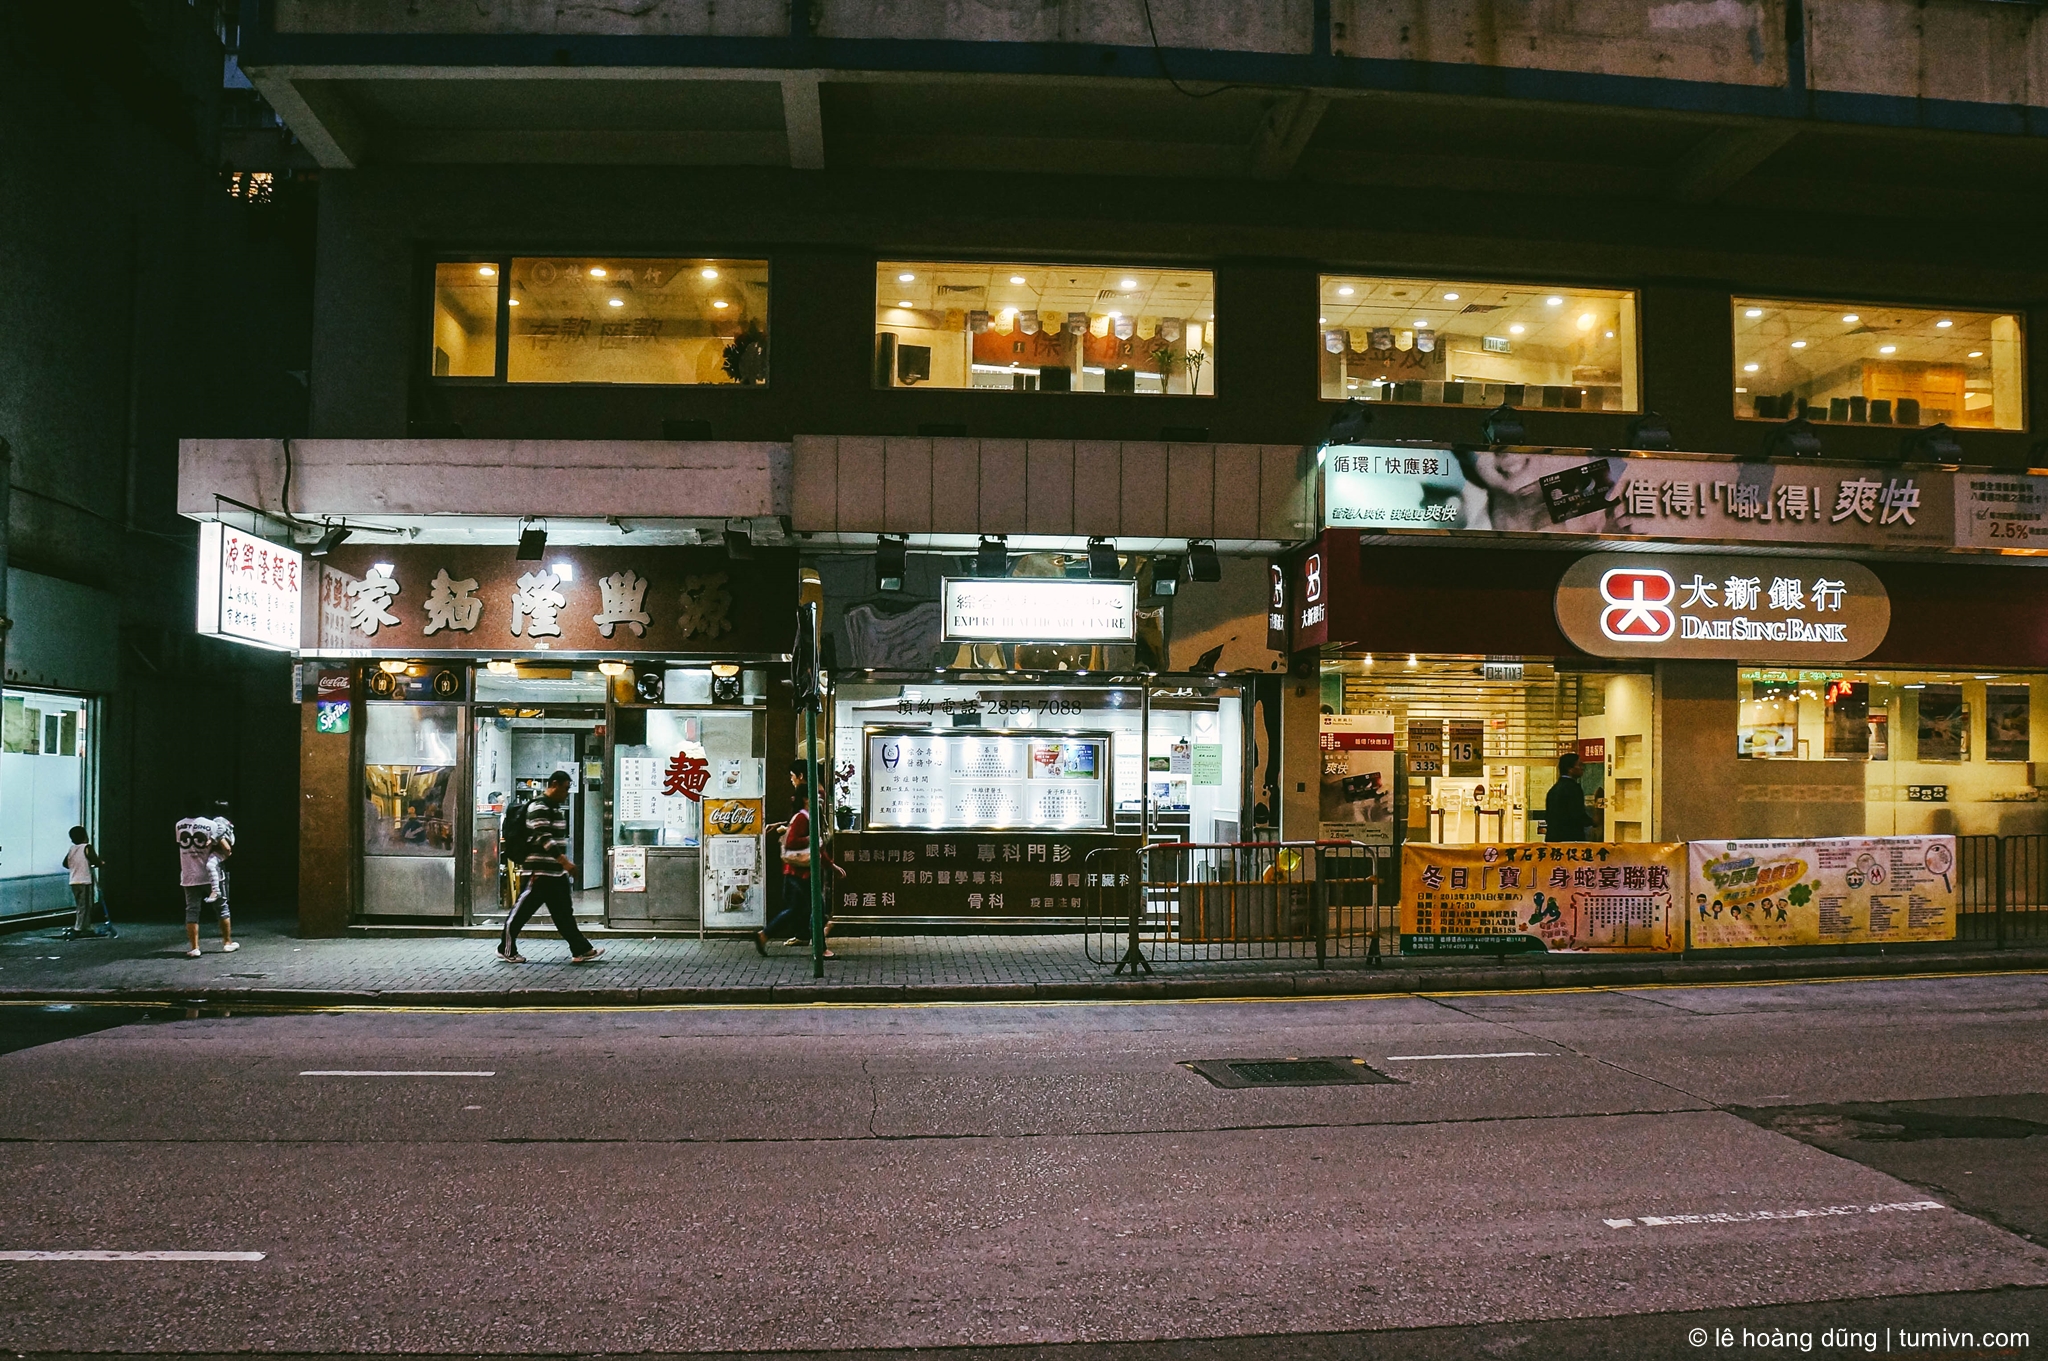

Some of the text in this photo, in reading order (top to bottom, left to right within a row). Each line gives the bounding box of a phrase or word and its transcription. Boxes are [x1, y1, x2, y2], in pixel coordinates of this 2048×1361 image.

[1334, 456, 1449, 476] 循環「快應錢」
[1831, 477, 1922, 525] 爽快
[1990, 522, 2029, 539] 2.5%
[1680, 574, 1848, 612] 大新銀行
[953, 615, 996, 627] EXPERT
[1082, 617, 1126, 629] CENTRE
[897, 699, 1082, 716] 預約電話 2855 7088
[320, 703, 349, 730] Sprite
[661, 751, 711, 802] 麵
[1325, 762, 1348, 774] 爽快
[926, 844, 956, 857] 眼科
[977, 844, 1071, 863] 專科門診
[1504, 847, 1610, 862] 寶石事務促進會
[903, 871, 1003, 885] 預防醫學專科
[1421, 865, 1670, 890] 冬日「寶」身蛇宴聯歡
[843, 892, 896, 907] 婦產科
[967, 893, 1005, 909] 骨科
